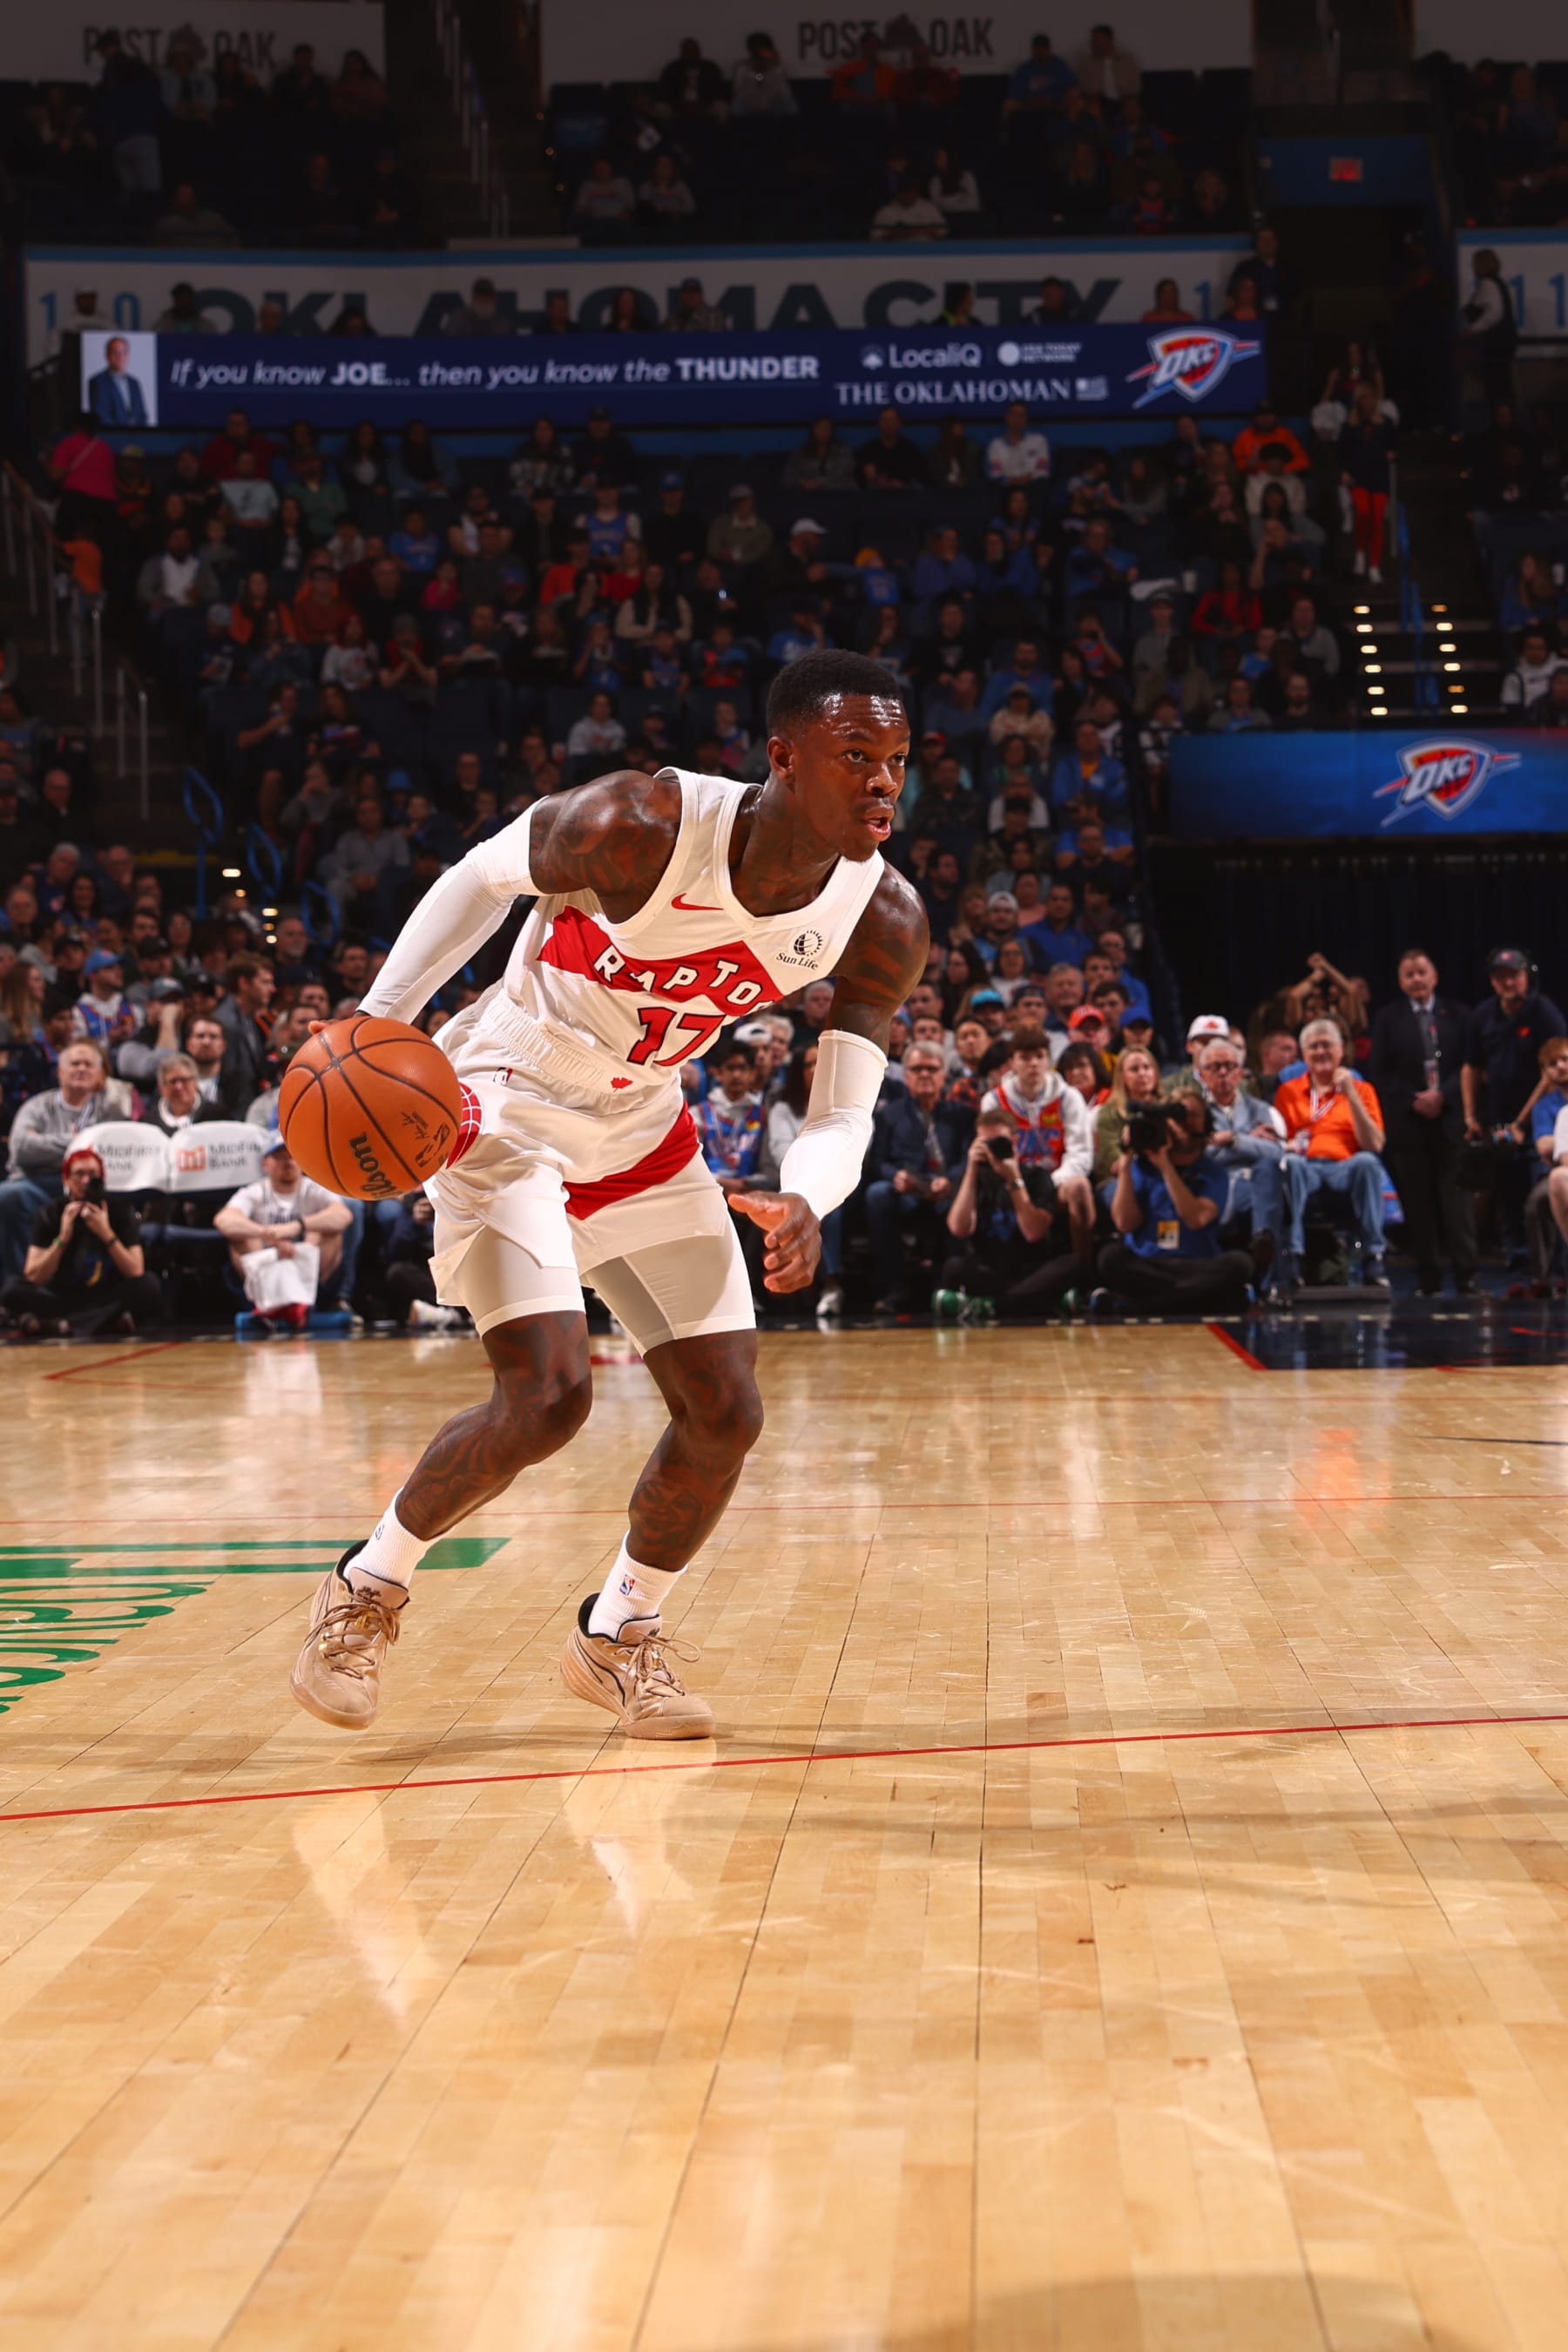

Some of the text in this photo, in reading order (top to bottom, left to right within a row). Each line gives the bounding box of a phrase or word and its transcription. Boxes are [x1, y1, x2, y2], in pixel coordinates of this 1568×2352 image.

[84, 26, 163, 66] PST
[929, 17, 994, 57] OAK
[170, 358, 194, 388] If
[194, 364, 247, 389] you
[253, 359, 327, 385] know
[417, 360, 482, 386] then
[484, 364, 539, 390] you
[543, 358, 618, 384] know
[623, 356, 672, 382] the
[674, 355, 821, 382] THUNDER
[889, 342, 983, 368] LocaliQ
[834, 377, 1071, 406] THE OKLAHOMAN
[594, 944, 774, 1011] RAPTO
[775, 951, 819, 970] Sun Life
[626, 1006, 727, 1067] 17
[348, 1131, 406, 1200] ilson
